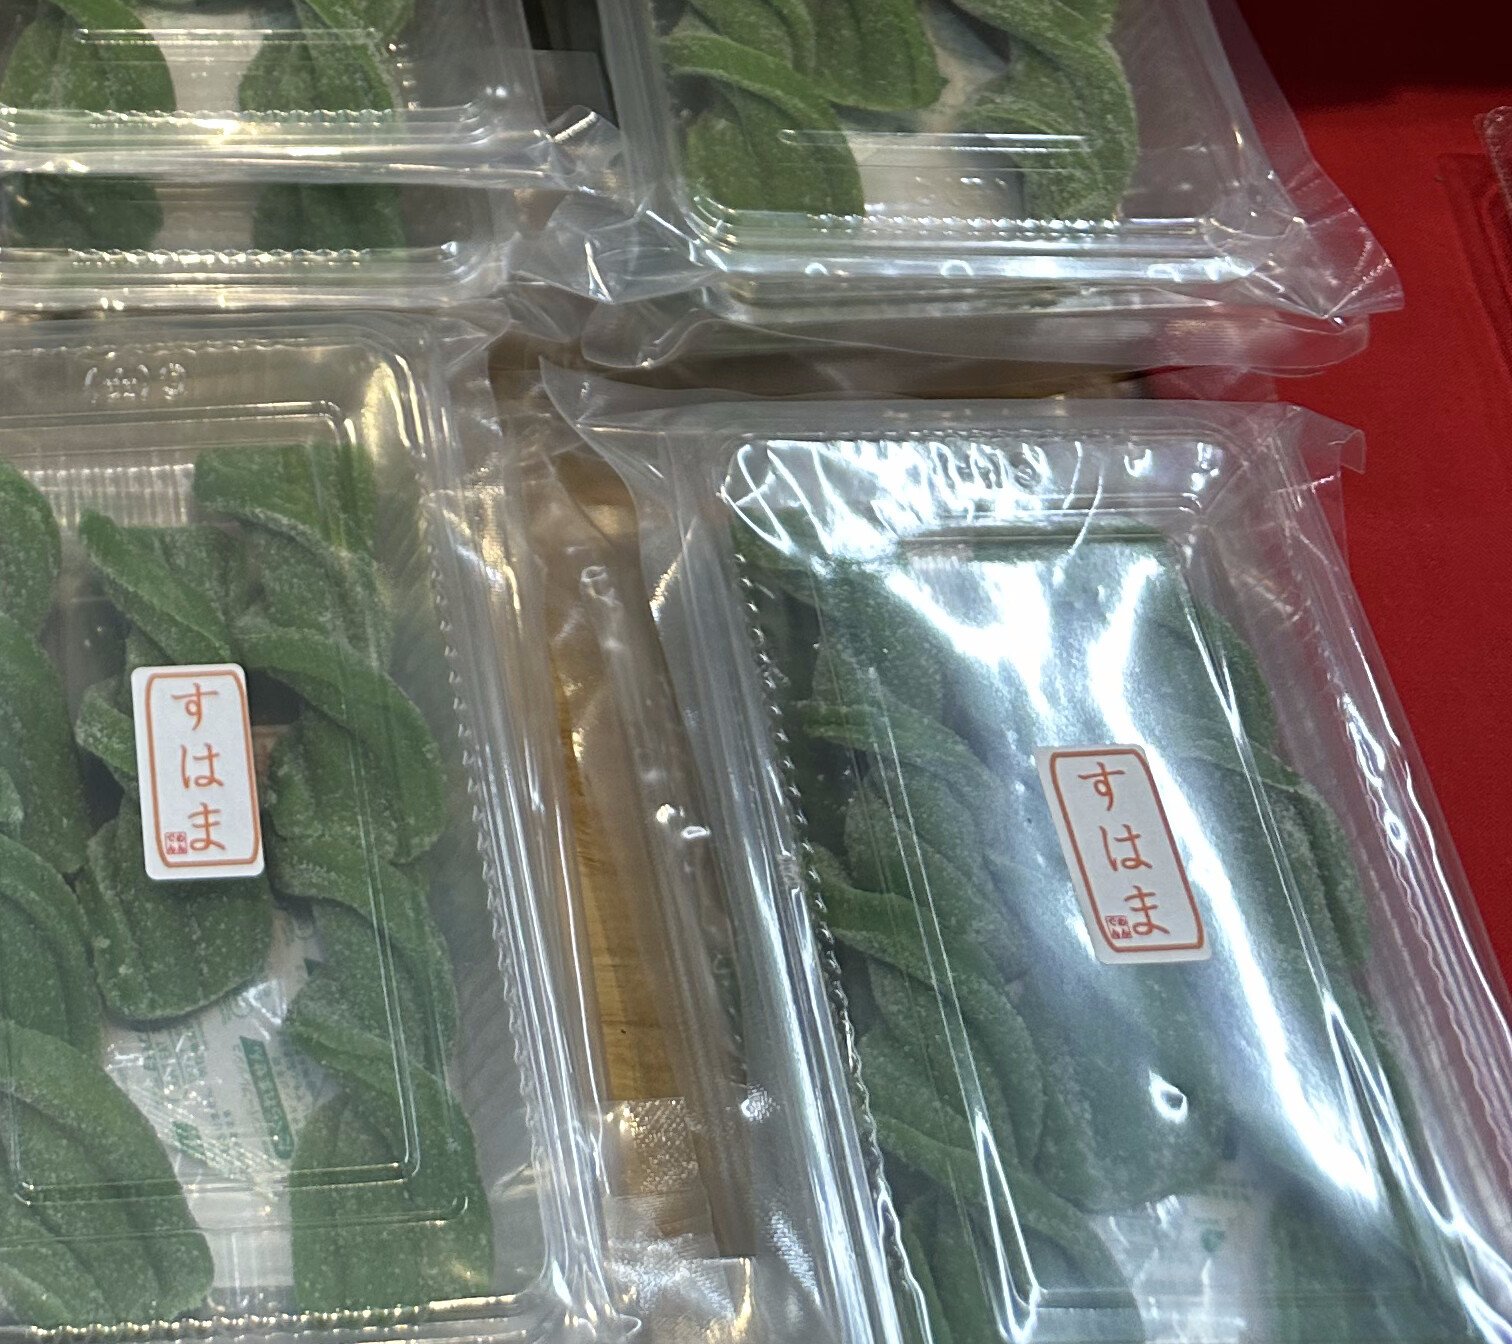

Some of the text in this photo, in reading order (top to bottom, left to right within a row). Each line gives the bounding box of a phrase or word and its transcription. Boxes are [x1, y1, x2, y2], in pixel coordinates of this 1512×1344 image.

[170, 683, 227, 853] すはま
[1078, 762, 1169, 940] すはま
